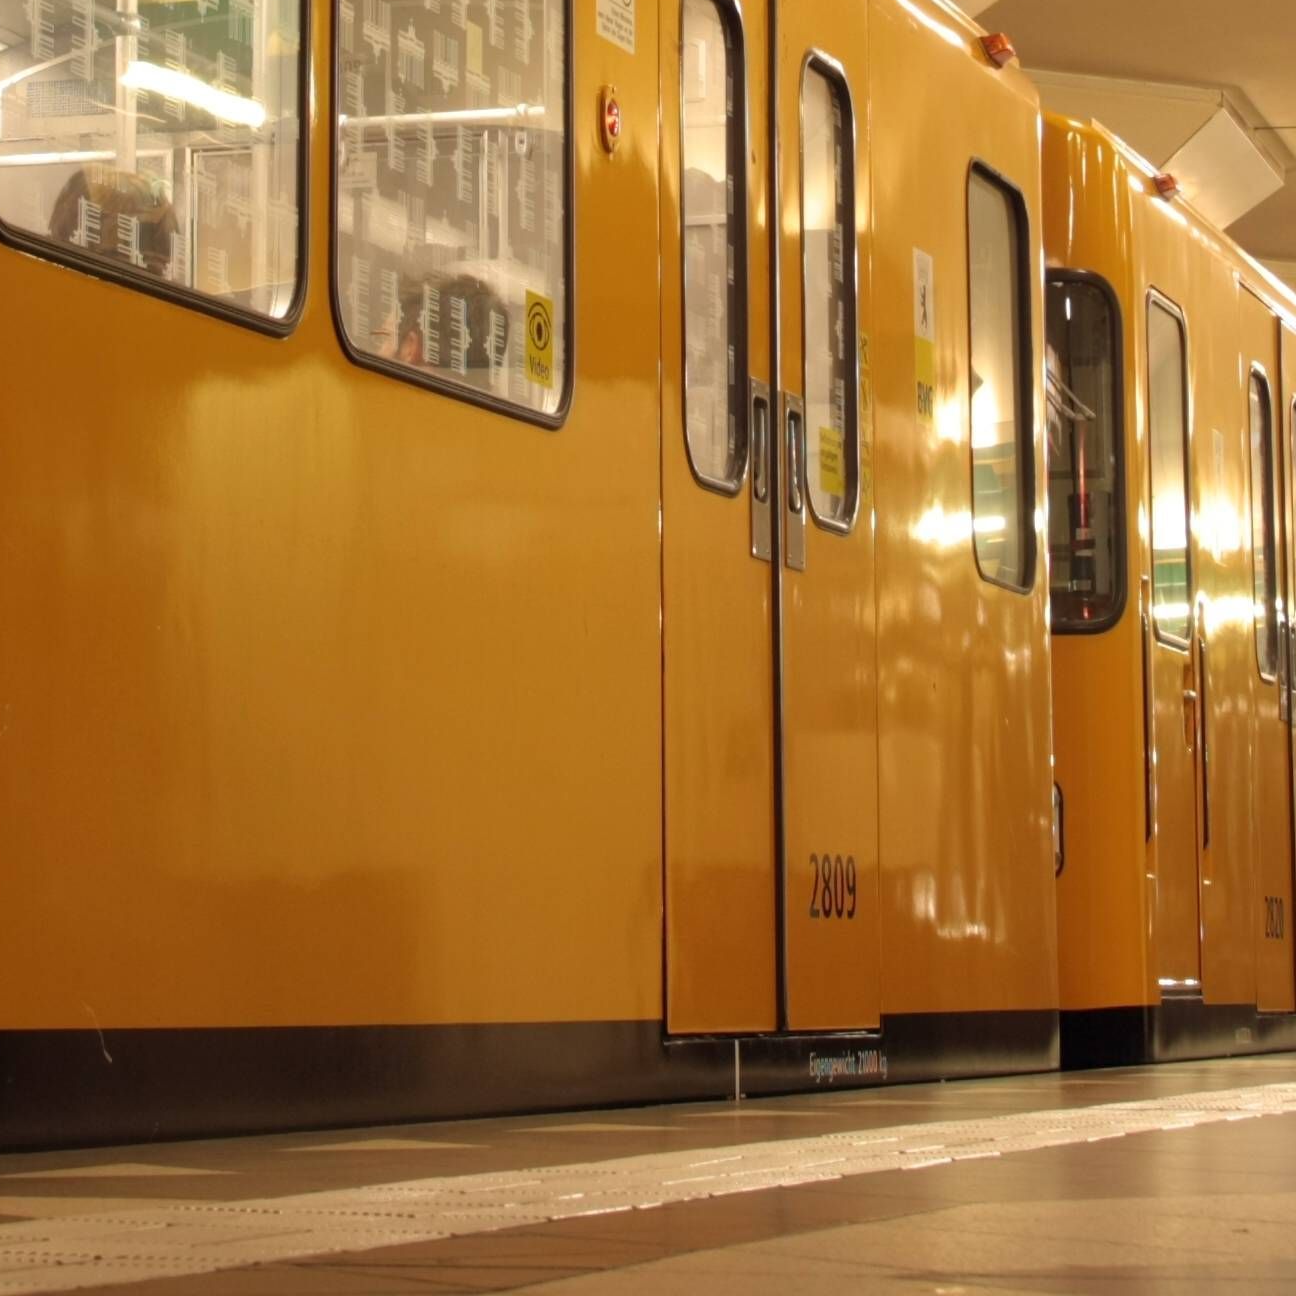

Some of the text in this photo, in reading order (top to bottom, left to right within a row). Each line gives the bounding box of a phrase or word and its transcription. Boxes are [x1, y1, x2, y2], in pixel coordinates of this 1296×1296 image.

[529, 354, 549, 380] Video
[917, 382, 933, 417] BVG
[809, 853, 857, 920] 2809
[809, 1049, 856, 1085] Eigengewicht
[879, 1049, 888, 1080] kg
